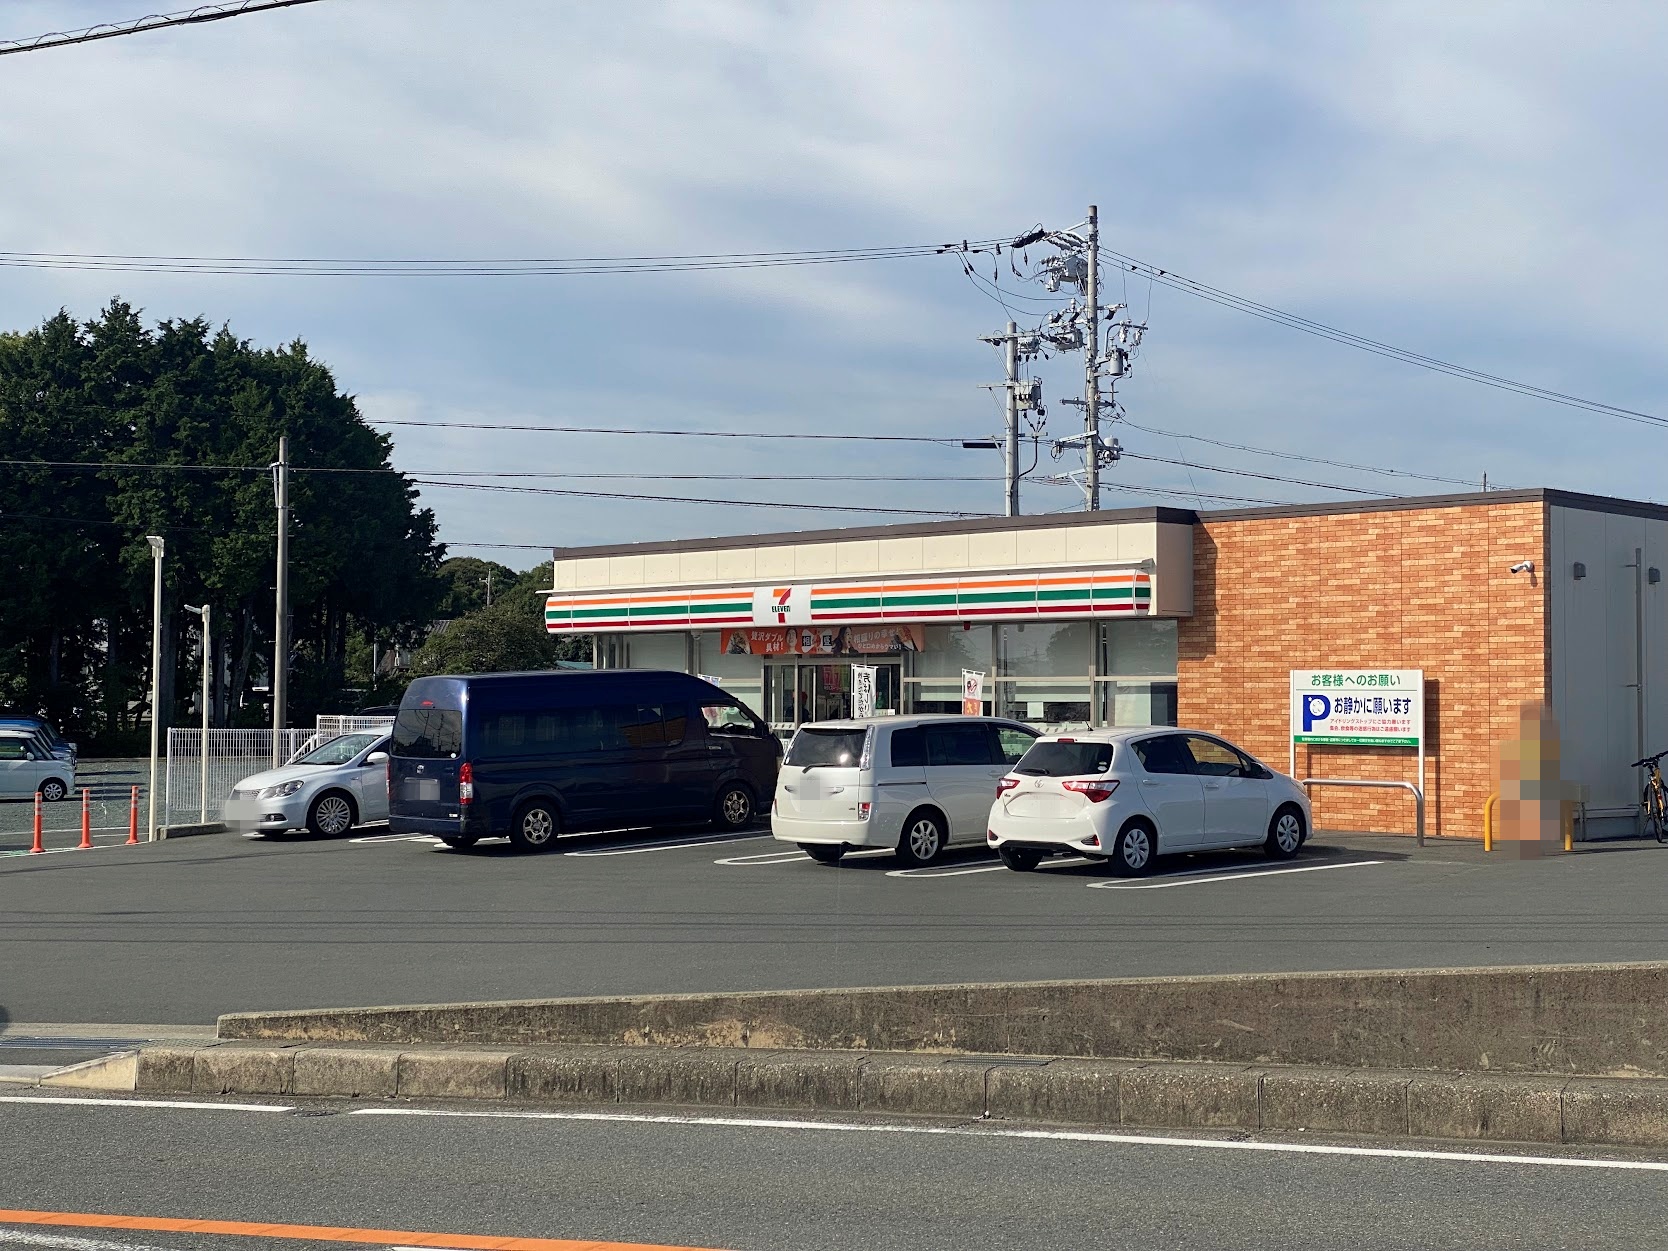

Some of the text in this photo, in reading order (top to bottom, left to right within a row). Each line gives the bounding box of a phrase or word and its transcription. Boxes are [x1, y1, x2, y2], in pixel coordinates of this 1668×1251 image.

[1311, 674, 1401, 687] お客様へのお願い
[1334, 696, 1412, 715] お静かに願います
